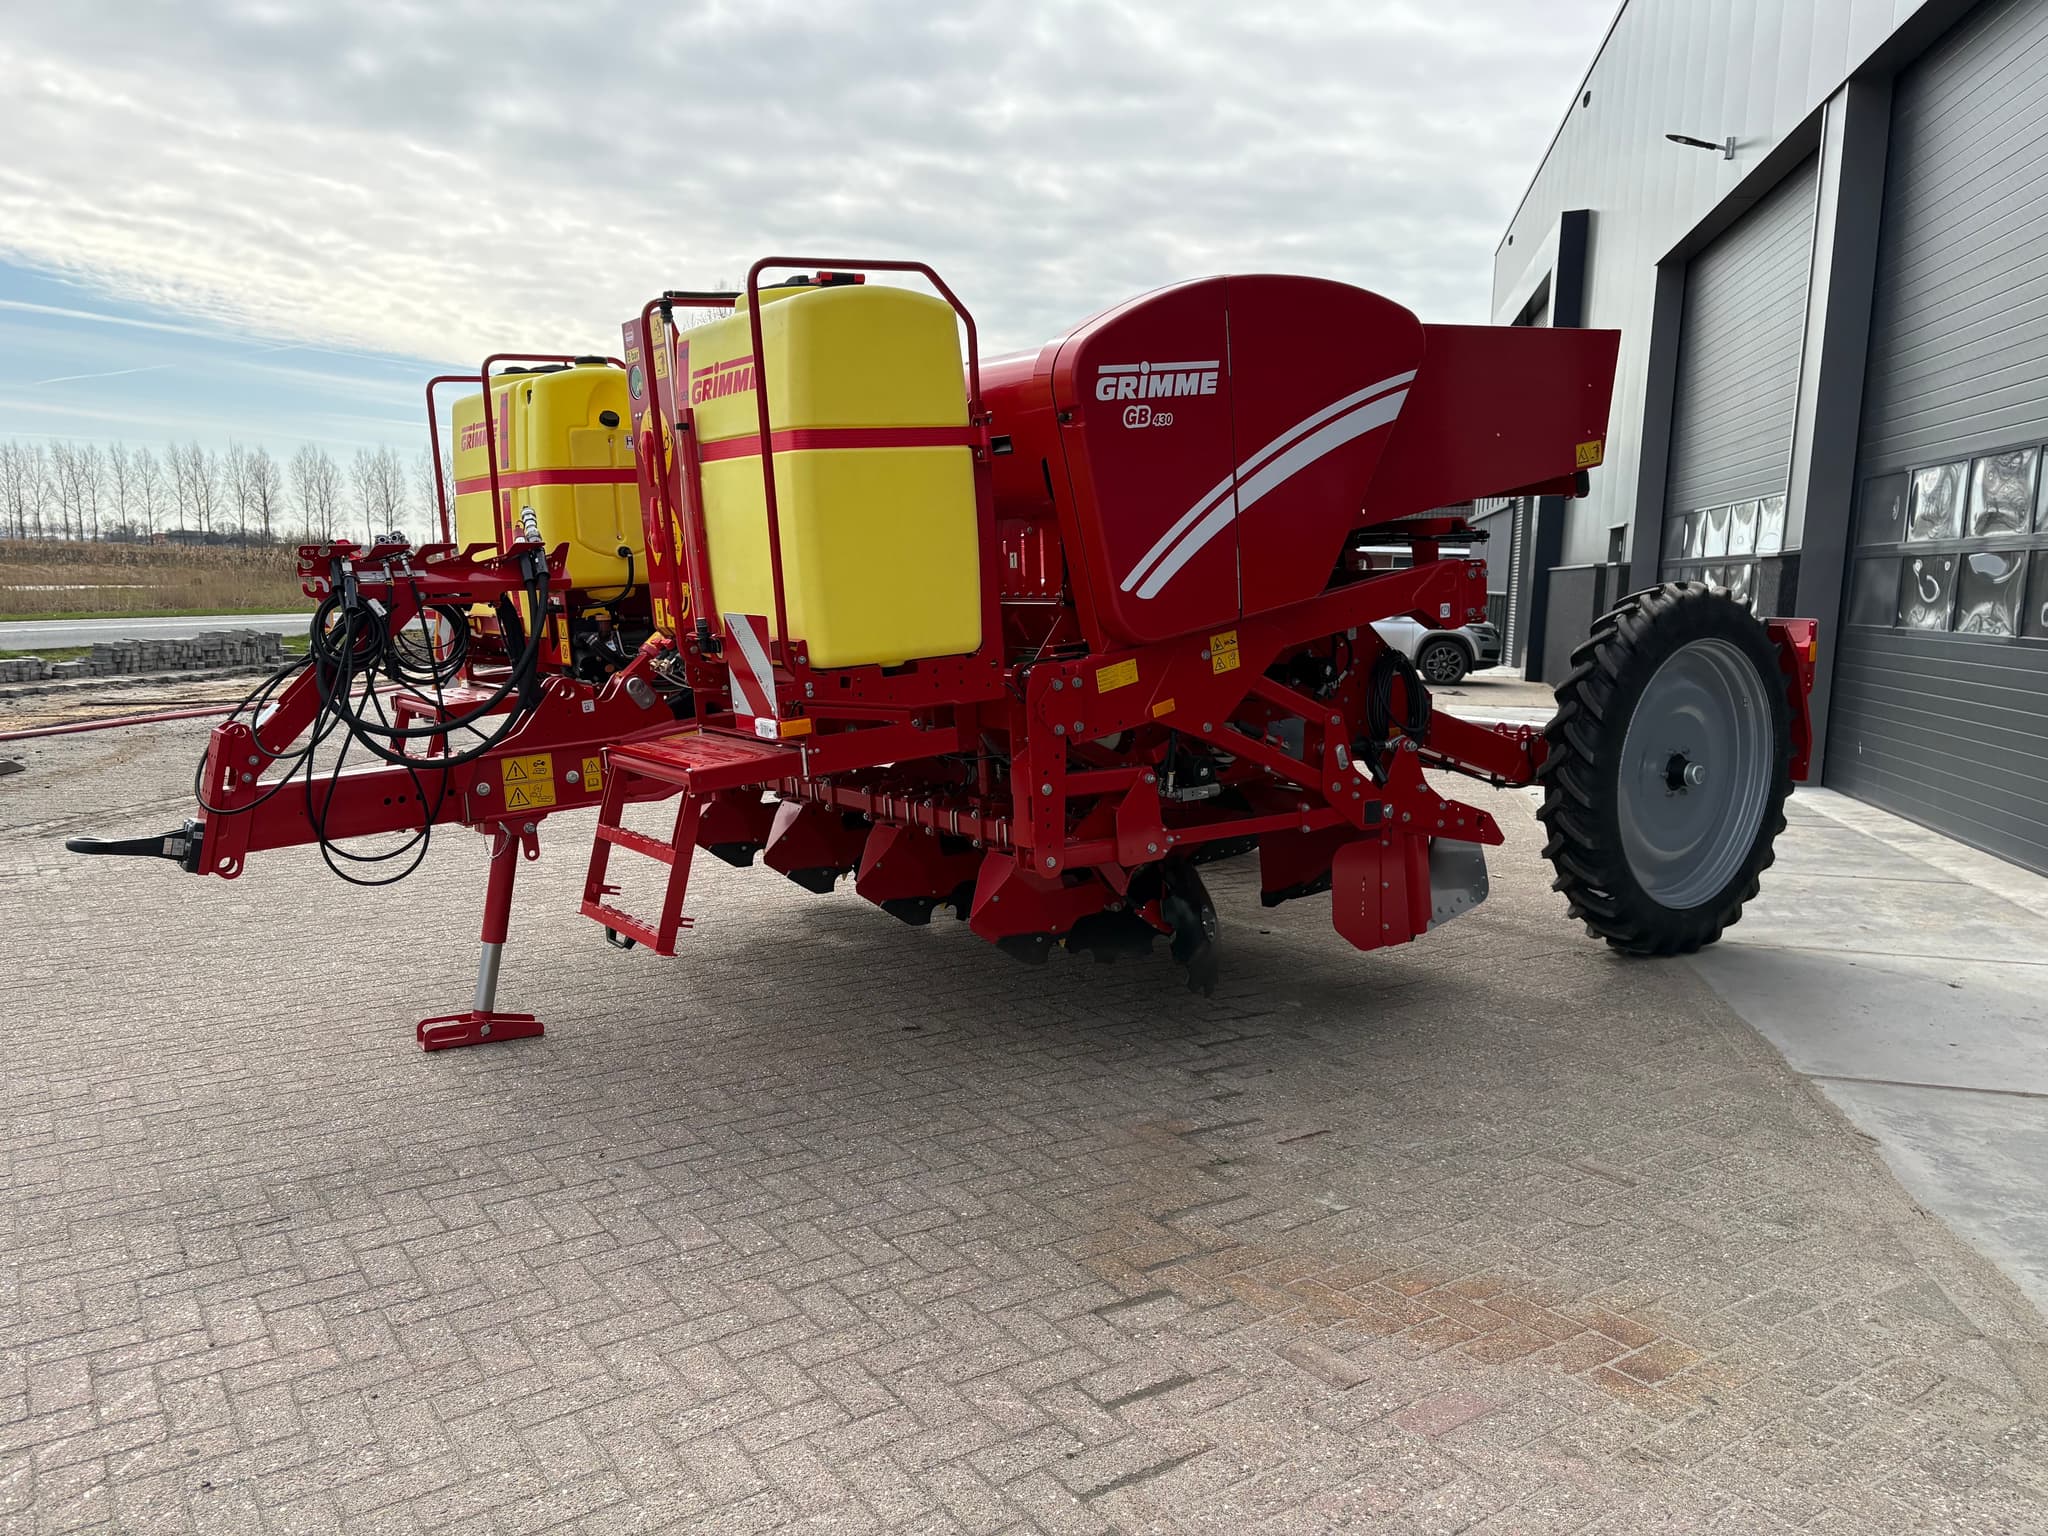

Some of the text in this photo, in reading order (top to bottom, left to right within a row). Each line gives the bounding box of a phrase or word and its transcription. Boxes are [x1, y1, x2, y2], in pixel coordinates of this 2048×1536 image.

[1096, 361, 1218, 401] GRIMME
[1123, 405, 1174, 429] GB 430
